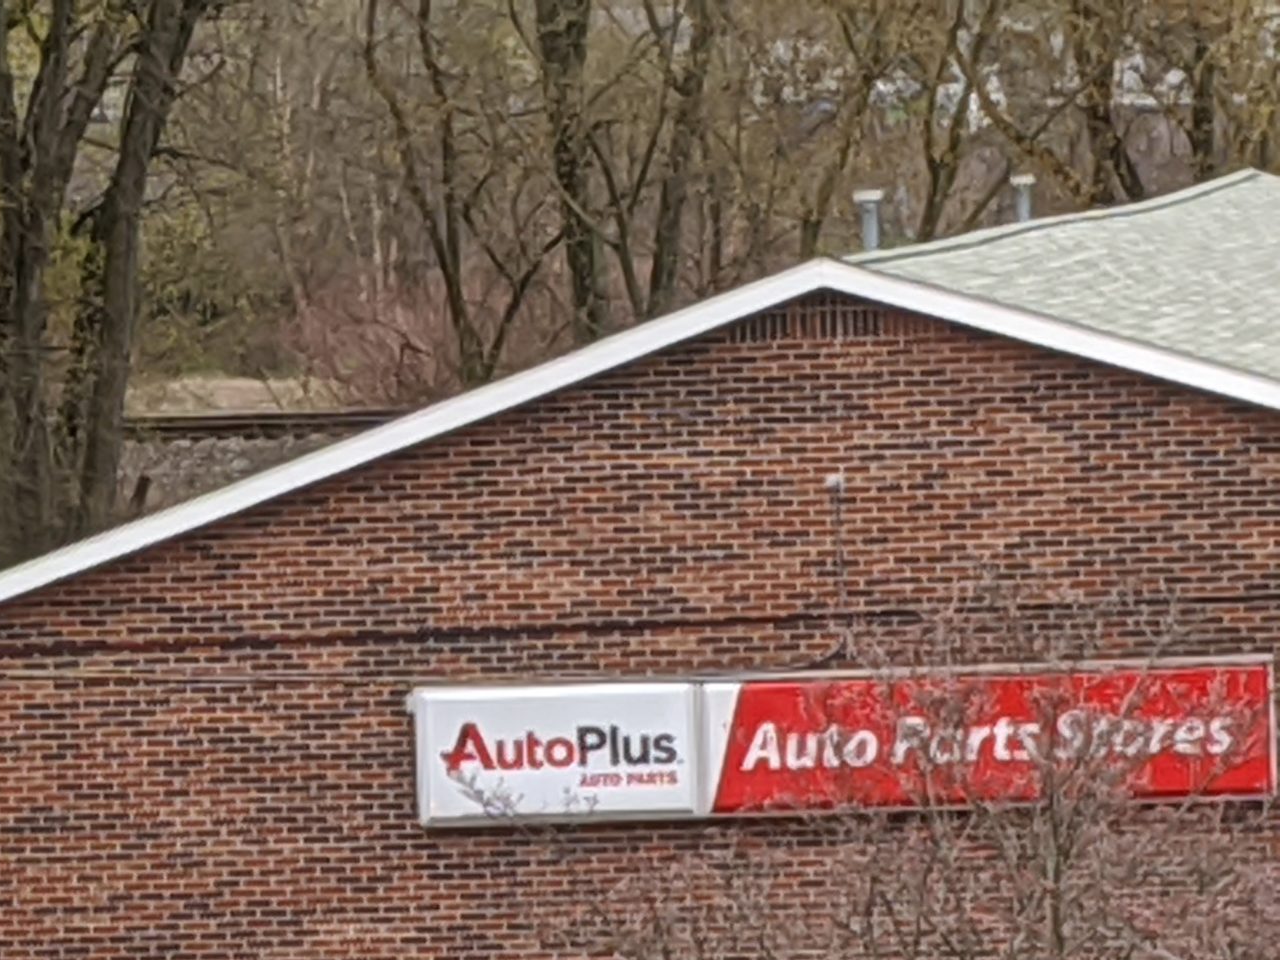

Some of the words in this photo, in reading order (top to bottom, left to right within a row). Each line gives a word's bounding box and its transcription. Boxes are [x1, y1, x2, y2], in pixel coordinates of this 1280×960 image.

[439, 722, 678, 771] AutoPlus
[739, 720, 879, 771] Auto
[891, 714, 1040, 765] Parts
[1053, 708, 1234, 760] Stores
[580, 773, 622, 788] AUTO
[626, 770, 678, 786] PARTS
